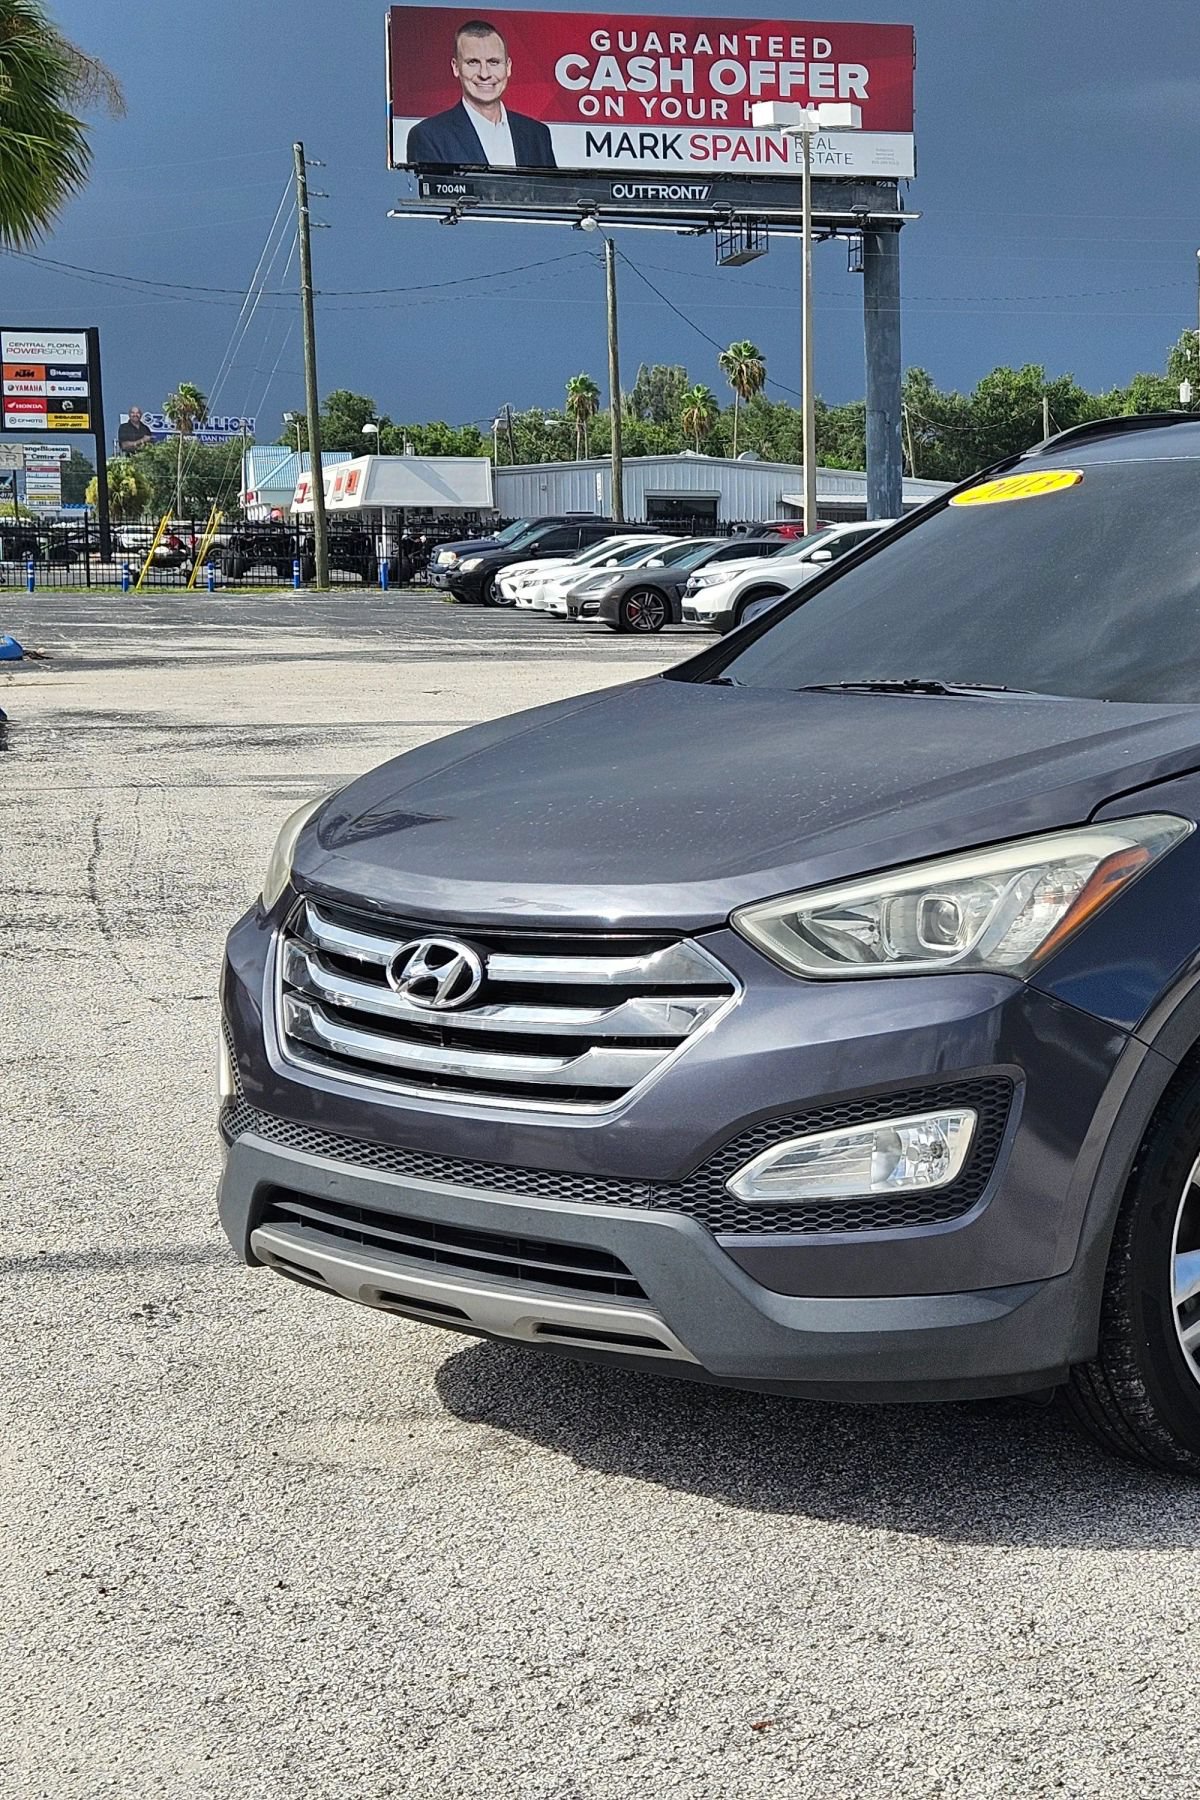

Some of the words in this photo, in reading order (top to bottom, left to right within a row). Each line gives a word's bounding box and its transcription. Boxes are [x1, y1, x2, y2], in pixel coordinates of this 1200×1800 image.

[590, 30, 832, 58] GUARANTEED
[555, 54, 694, 93] CASH
[709, 59, 870, 99] OFFER
[578, 95, 625, 117] ON
[639, 97, 728, 120] YOUR
[585, 131, 683, 160] MARK
[690, 134, 788, 163] SPAIN
[794, 137, 837, 150] REAL
[795, 152, 854, 165] ESTATE
[436, 184, 466, 194] 7004N
[6, 347, 84, 356] POWERSPORTS
[14, 369, 35, 378] KTM
